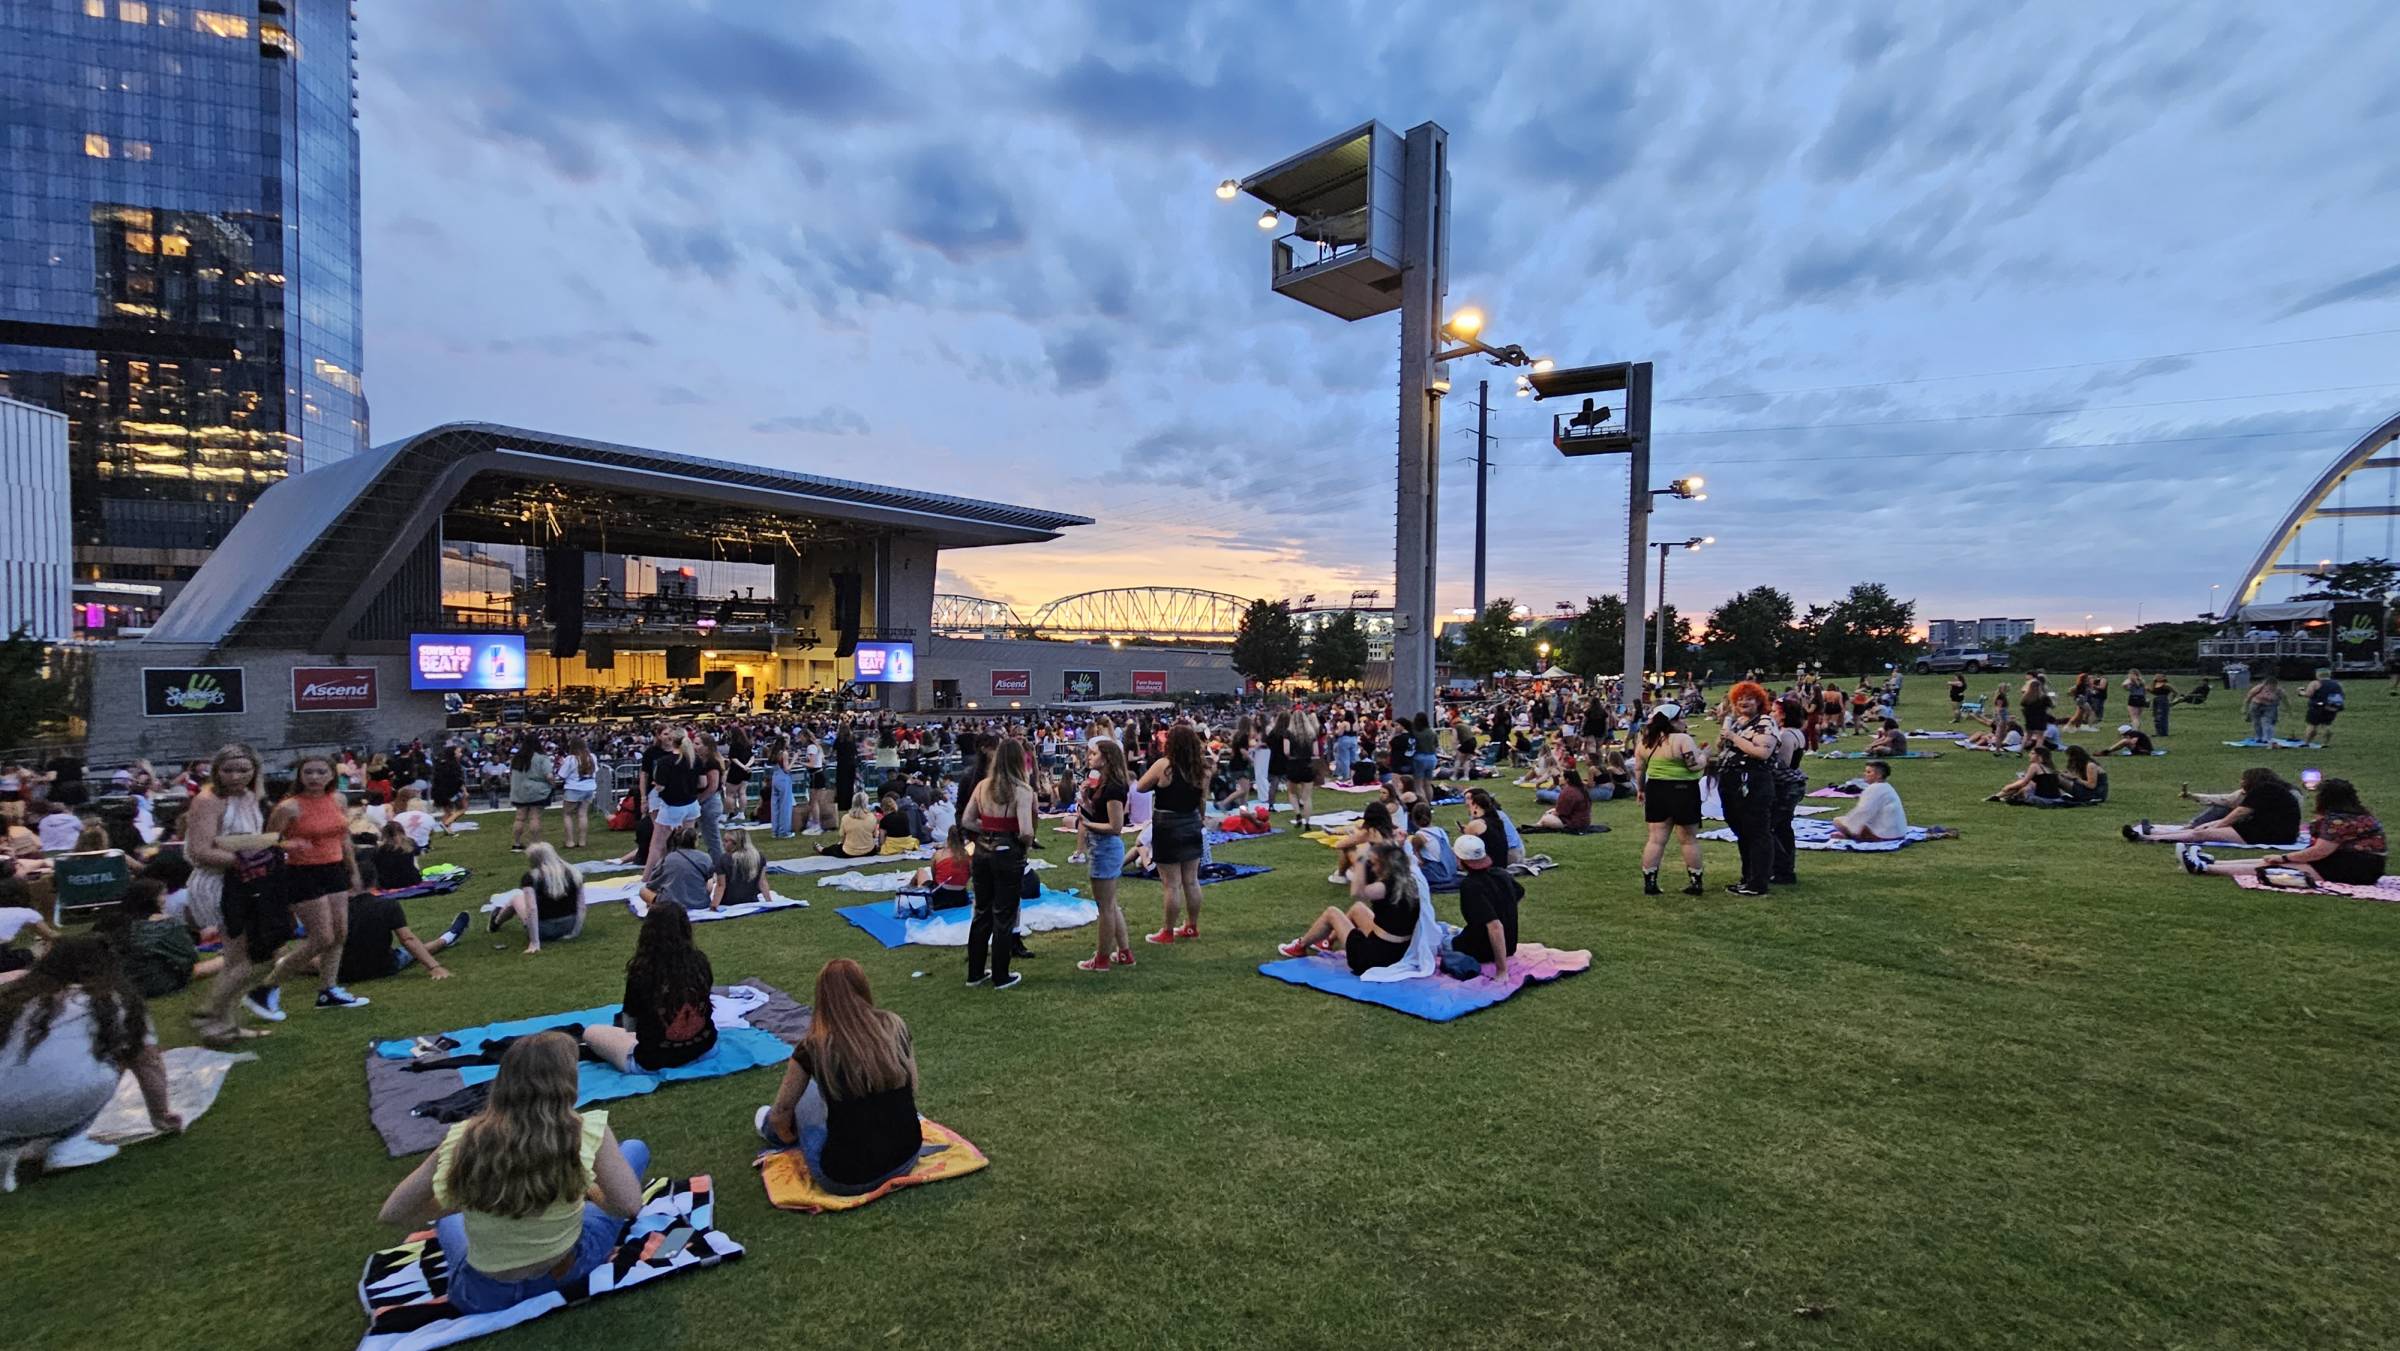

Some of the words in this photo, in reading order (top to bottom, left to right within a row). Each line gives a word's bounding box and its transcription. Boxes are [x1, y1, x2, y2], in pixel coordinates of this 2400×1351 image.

[420, 656, 471, 672] BEAT?
[303, 683, 369, 696] Ascend
[995, 679, 1027, 688] Ascend
[67, 871, 117, 885] RENTAL
